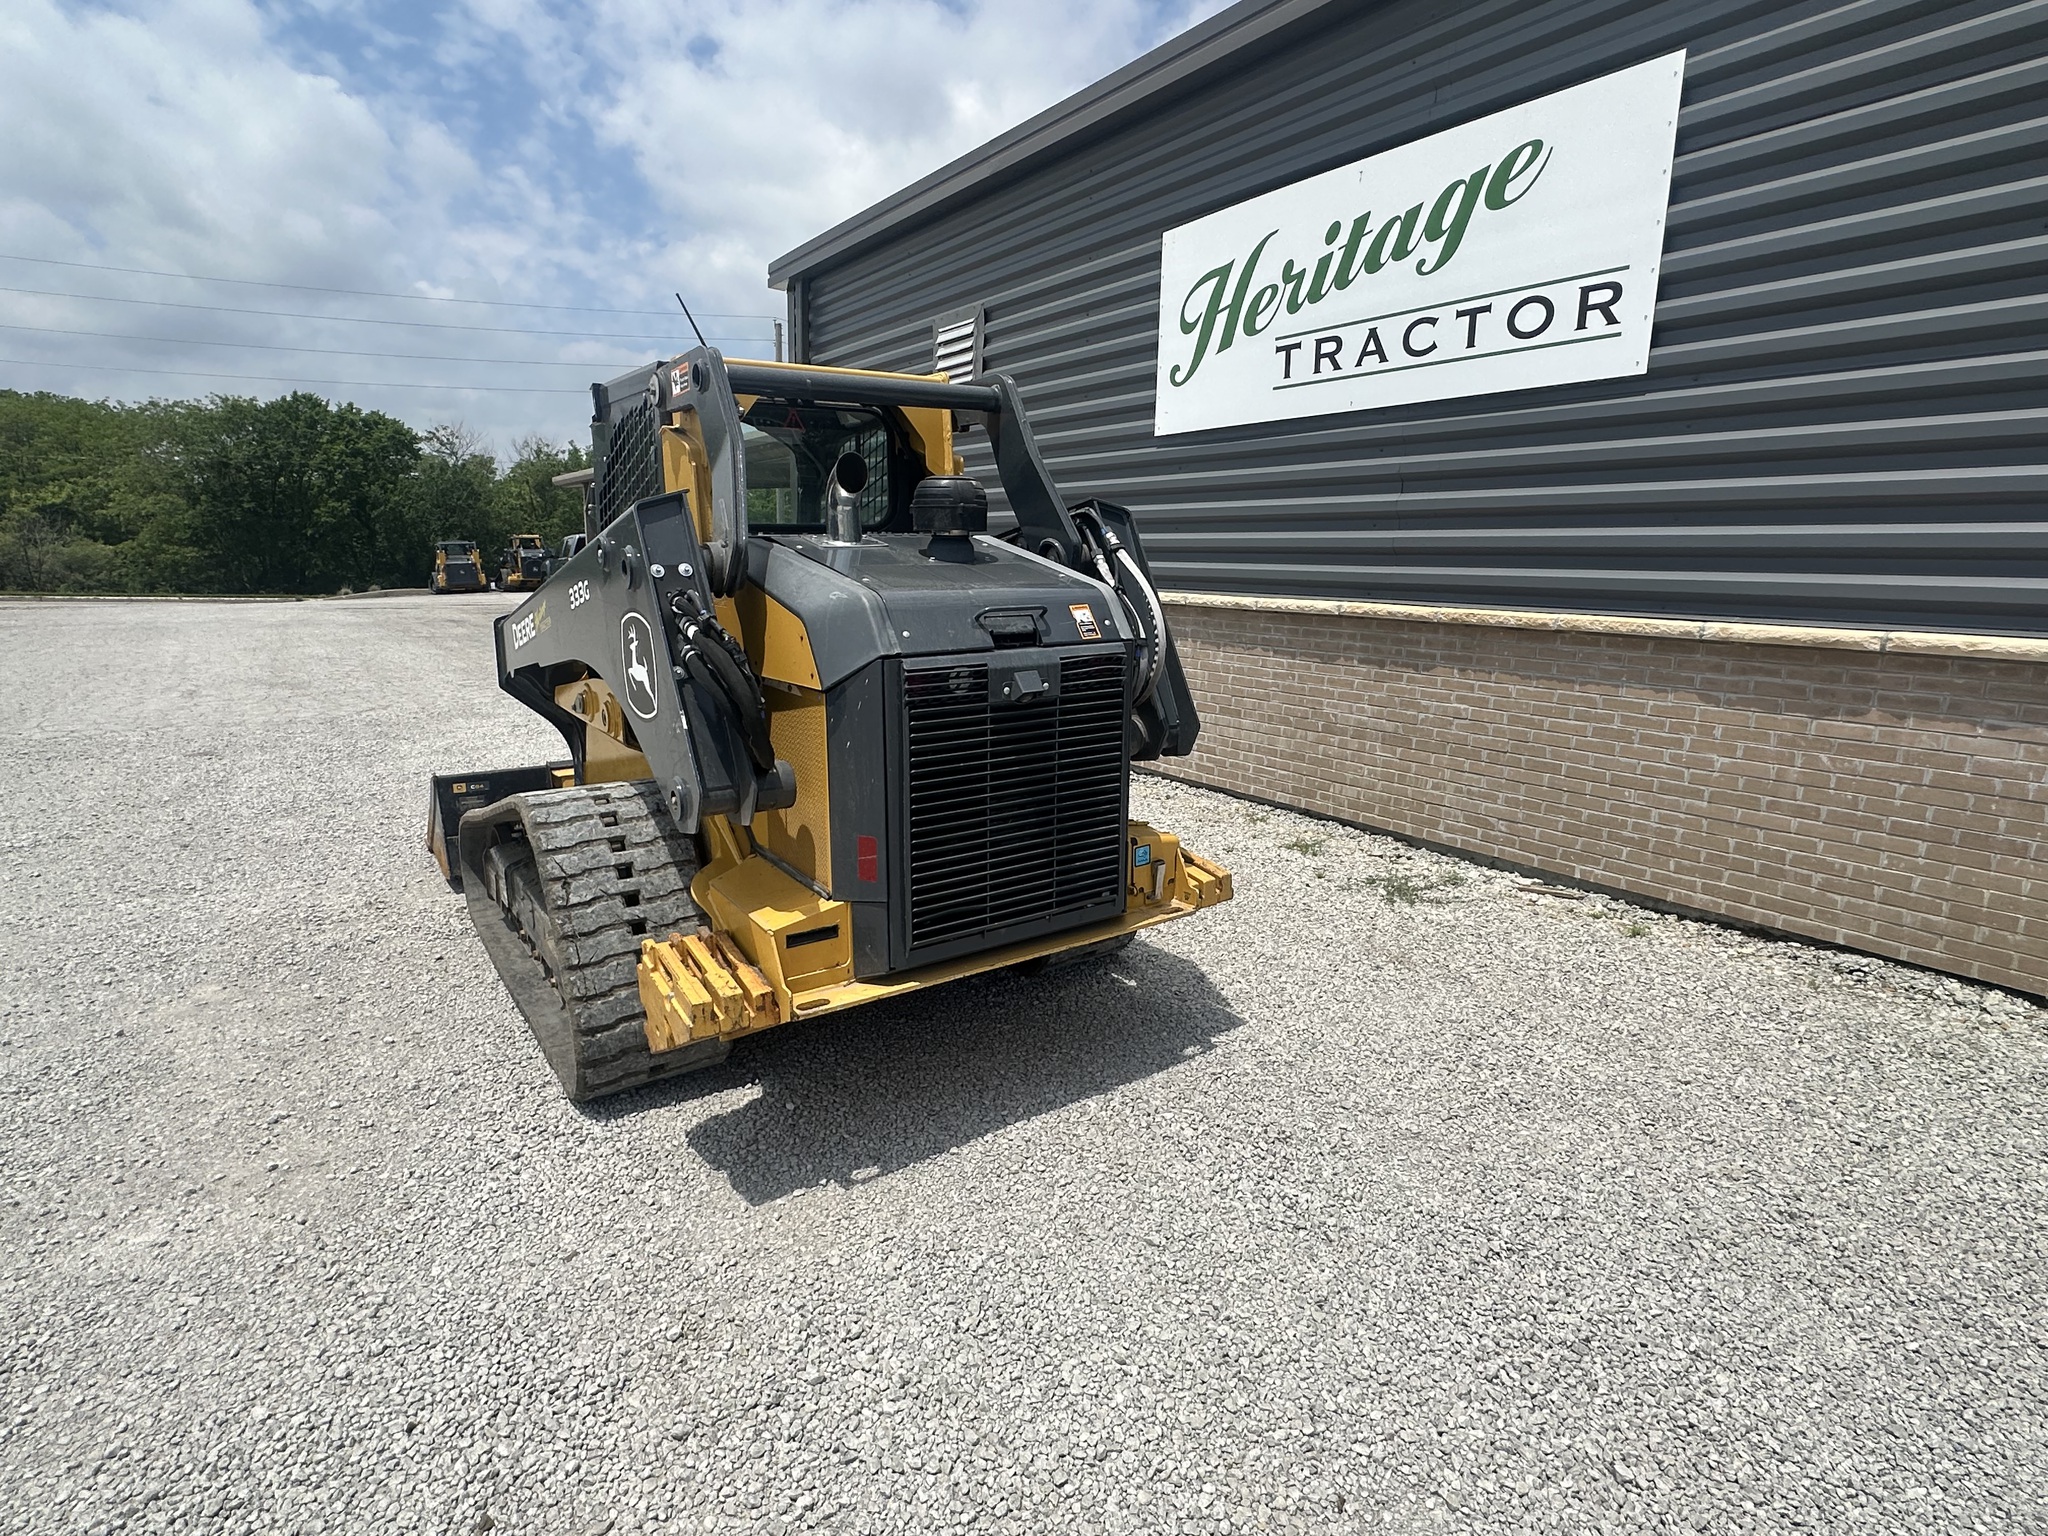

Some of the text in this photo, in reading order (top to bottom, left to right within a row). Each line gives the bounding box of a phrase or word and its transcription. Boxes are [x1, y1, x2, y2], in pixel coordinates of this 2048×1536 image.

[1169, 138, 1553, 387] Heritage
[1275, 280, 1624, 380] TRACTOR
[568, 579, 590, 610] 333G
[511, 612, 536, 650] DEERE
